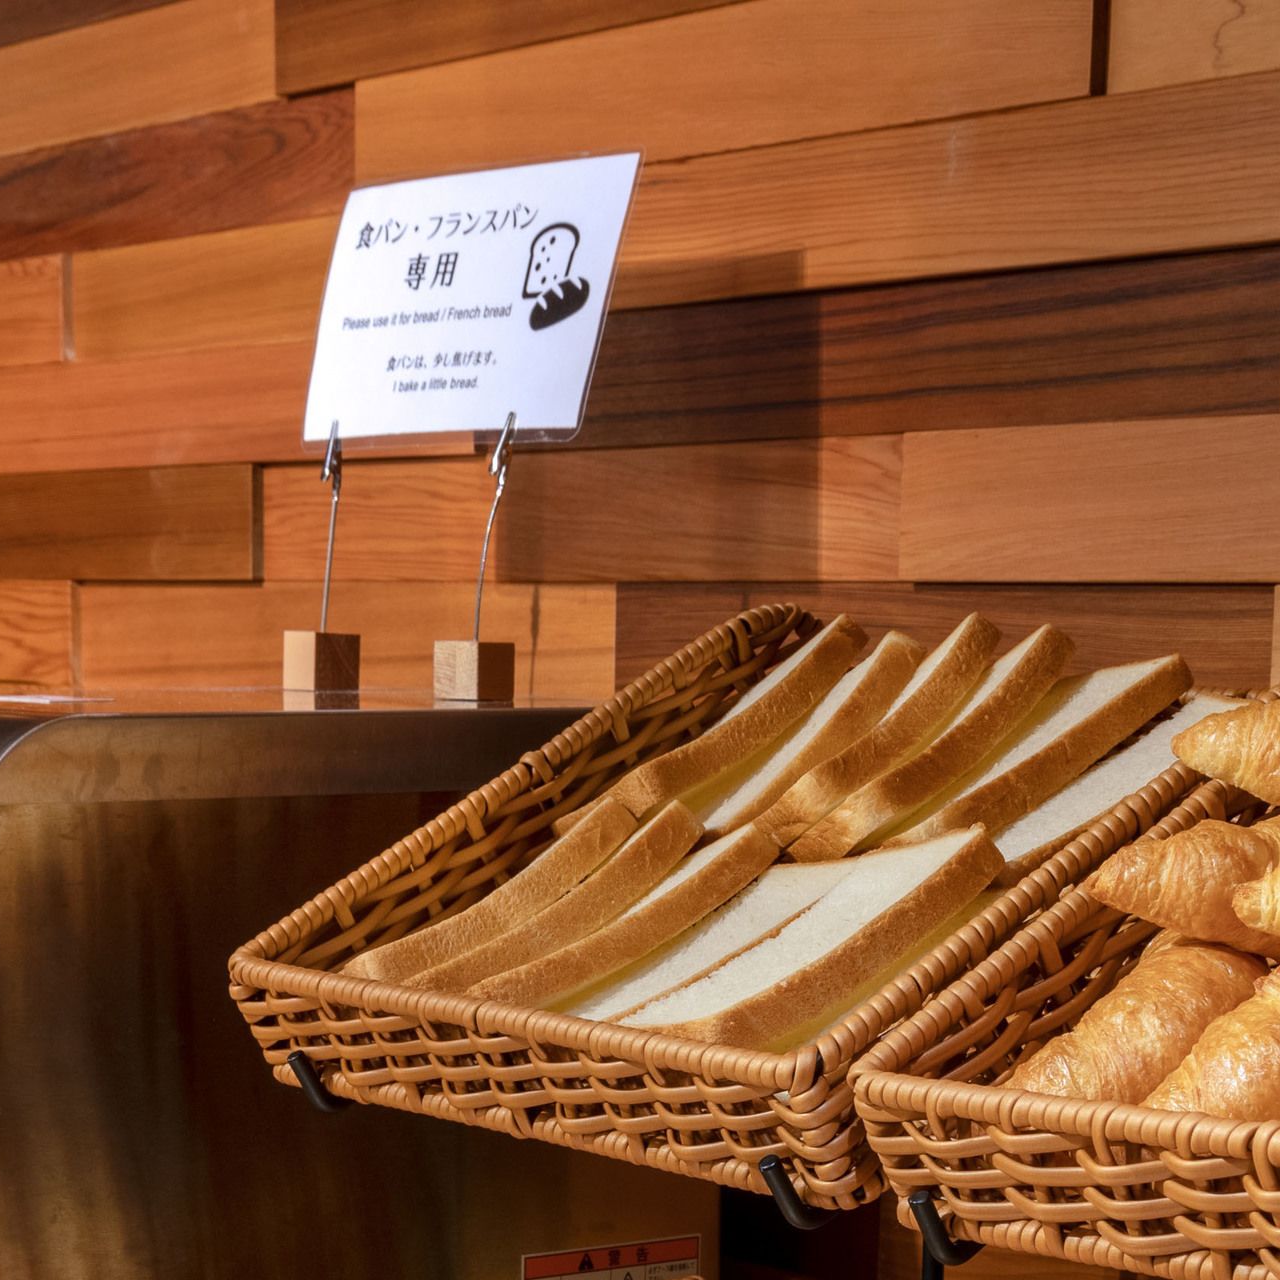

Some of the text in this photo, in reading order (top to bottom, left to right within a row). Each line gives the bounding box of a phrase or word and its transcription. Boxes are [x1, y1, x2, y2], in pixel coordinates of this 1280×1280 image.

[356, 203, 539, 249] 食パン・フランスパン
[404, 252, 459, 291] 専用
[342, 317, 371, 330] Please
[372, 316, 388, 328] use
[391, 313, 397, 325] it
[399, 312, 411, 325] for
[413, 309, 440, 324] bread
[447, 305, 481, 321] French
[483, 303, 512, 318] bread
[398, 380, 419, 392] bake
[421, 382, 427, 391] a
[428, 377, 447, 390] little
